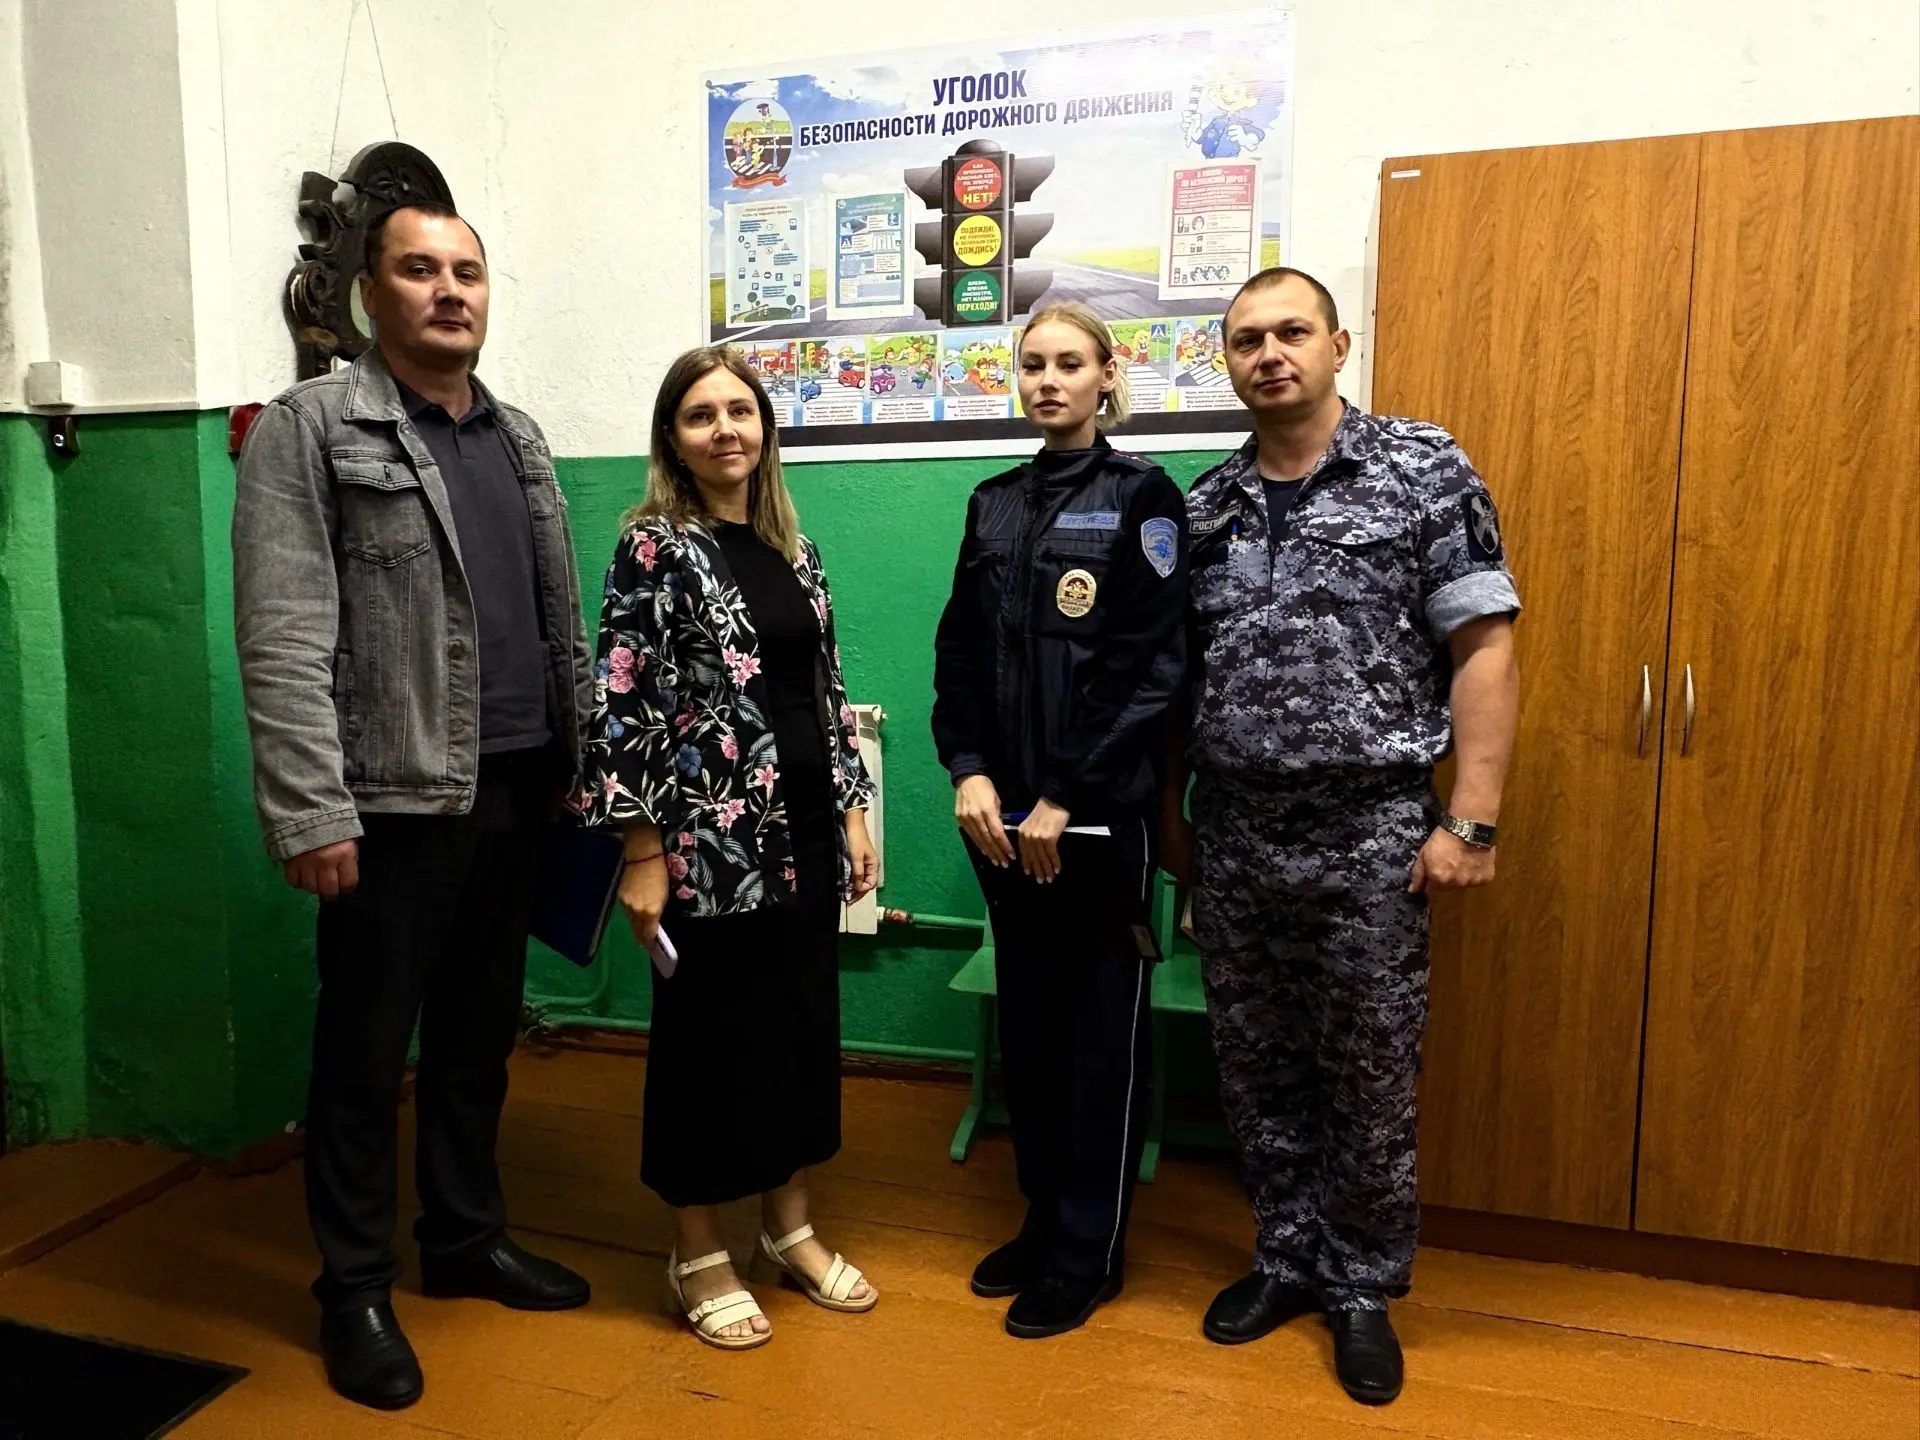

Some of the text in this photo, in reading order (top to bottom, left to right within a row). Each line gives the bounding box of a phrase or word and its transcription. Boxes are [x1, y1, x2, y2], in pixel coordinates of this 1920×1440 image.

[932, 69, 1027, 107] УГОЛОК
[800, 90, 1173, 147] БЕЗОПАСНОСТИ ДОРОЖНОГО ДВИЖЕНИЯ
[962, 192, 993, 204] НЕТ!
[958, 244, 998, 256] ДОЖДИСЬ!
[956, 301, 998, 312] ПЕРЕХОДИ!
